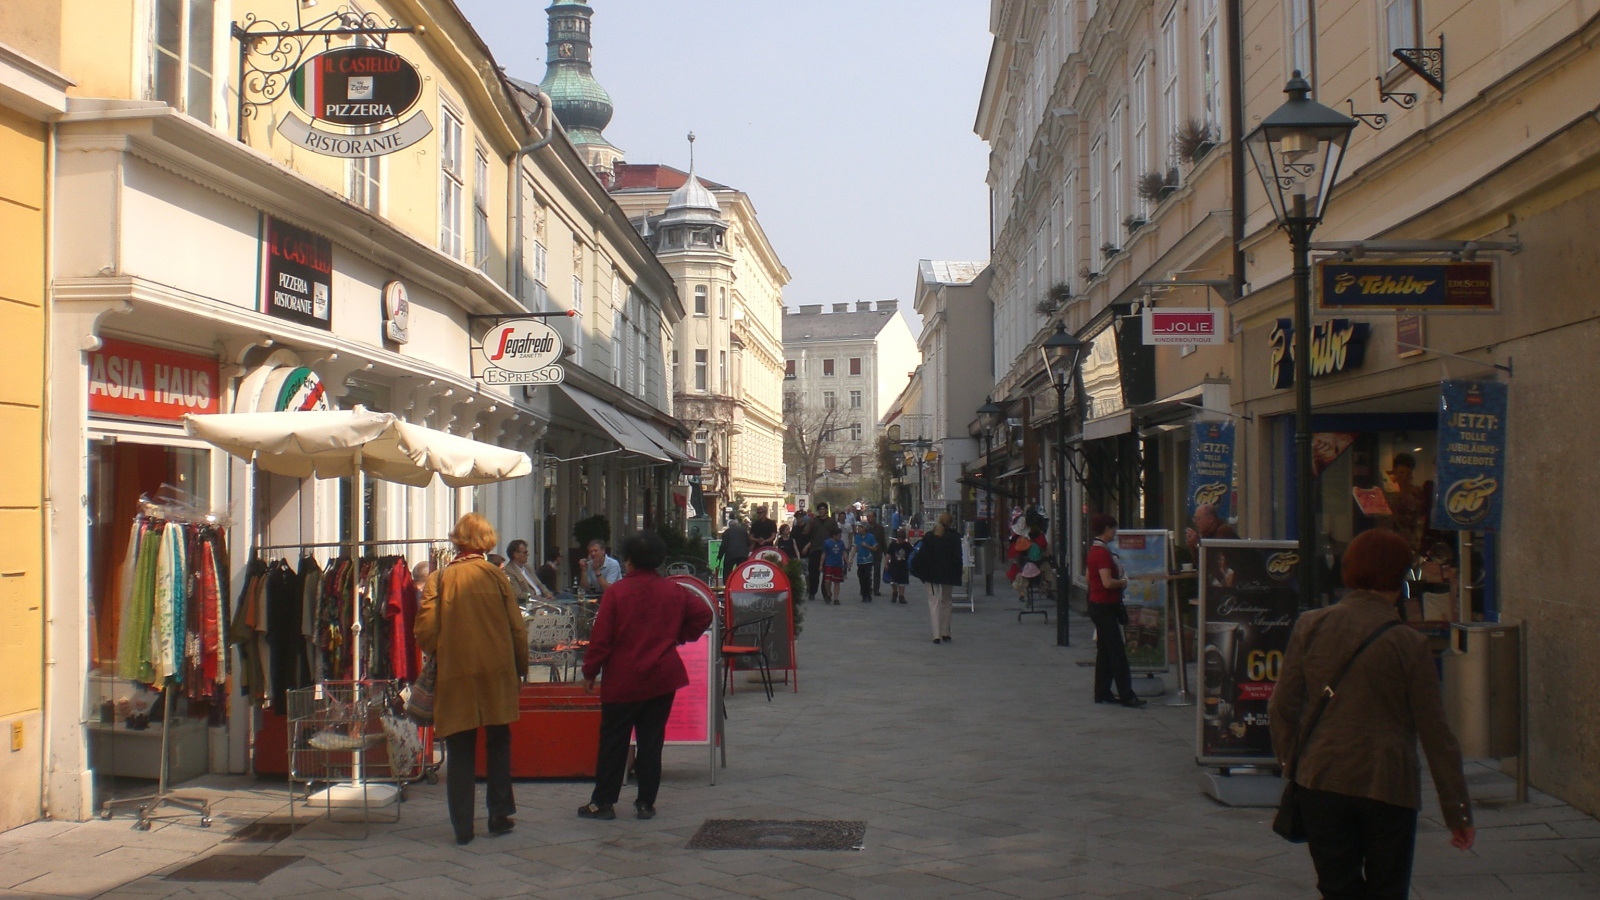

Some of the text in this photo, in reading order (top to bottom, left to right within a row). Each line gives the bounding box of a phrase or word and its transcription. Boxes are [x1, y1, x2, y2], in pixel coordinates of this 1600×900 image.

[325, 56, 401, 73] IL CASTELLO
[350, 83, 370, 92] Zipfer
[326, 103, 394, 116] PIZZERIA
[304, 131, 404, 154] RISTORANTE
[271, 231, 332, 274] IL CASTELLO
[279, 272, 309, 295] PIZZERIA
[1357, 275, 1437, 296] Tchibo
[274, 291, 312, 315] RISTORANTE
[490, 327, 555, 361] Segafredo
[89, 353, 210, 410] ASIA HAUS
[488, 367, 561, 383] ESPRESSO
[1447, 412, 1499, 429] JETZT:
[1460, 431, 1486, 441] TOLLE
[1197, 442, 1230, 454] JETZT:
[1446, 442, 1499, 454] JUBILÄUMS-
[1449, 455, 1496, 467] ANGEBOTE
